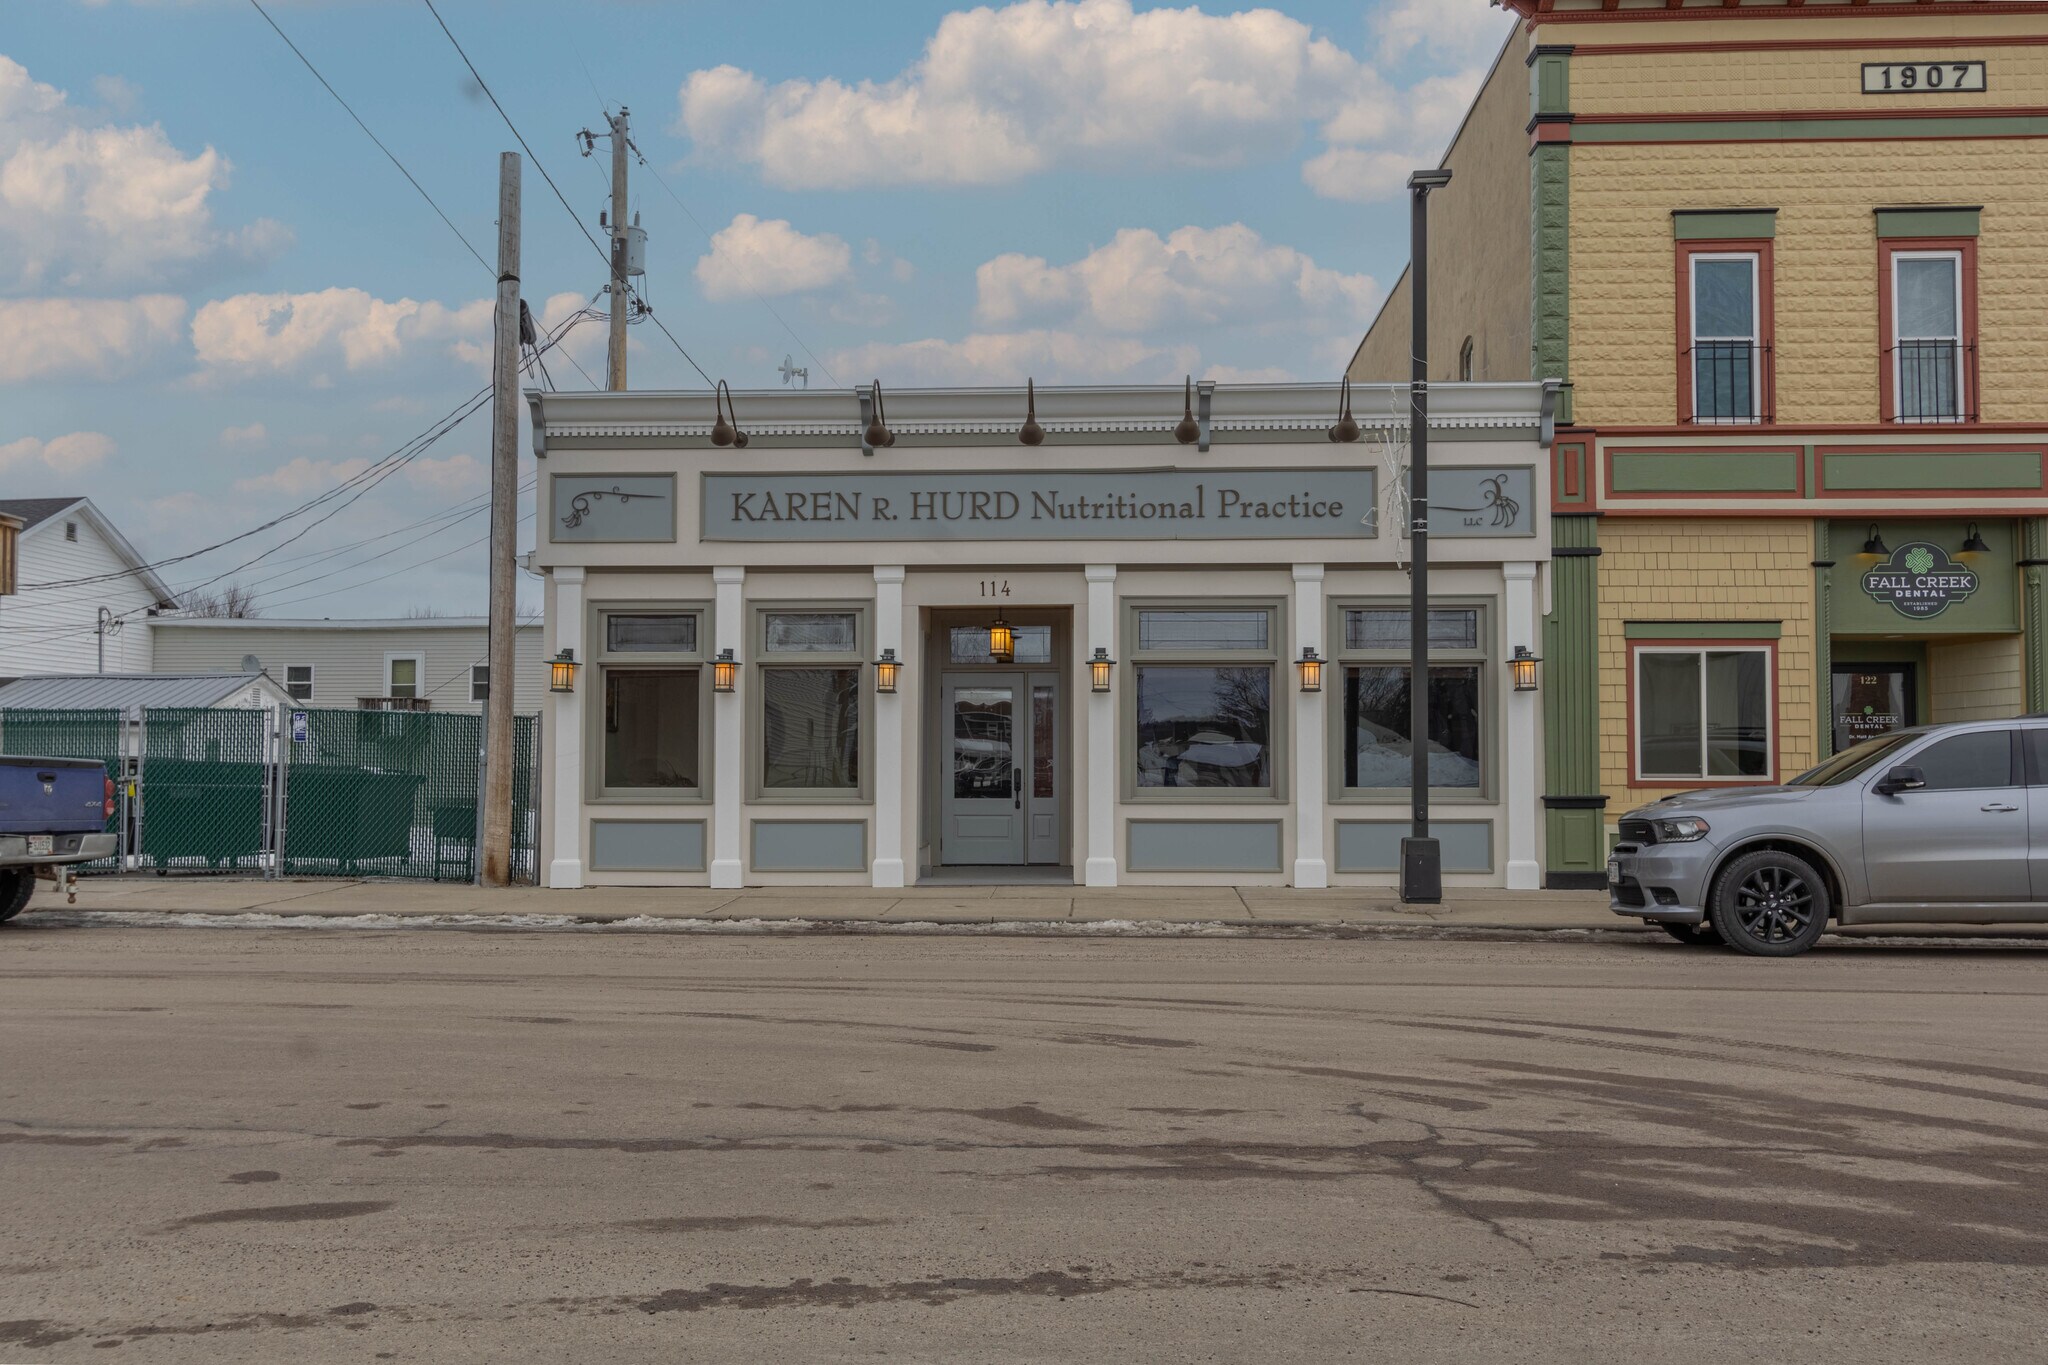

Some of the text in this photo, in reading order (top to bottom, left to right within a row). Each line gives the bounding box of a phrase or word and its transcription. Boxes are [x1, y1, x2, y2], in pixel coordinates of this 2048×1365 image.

[1881, 65, 1969, 89] 1907
[731, 491, 862, 521] KAREN
[910, 491, 1020, 520] HURD
[1030, 484, 1206, 519] Nutritional
[1217, 488, 1344, 519] Practice
[1463, 517, 1483, 526] LLC
[1869, 576, 1972, 589] FALL CREEK
[980, 580, 1011, 597] 114
[1895, 590, 1946, 598] DENTAL
[1860, 676, 1877, 684] 122
[1866, 715, 1898, 723] CREEK
